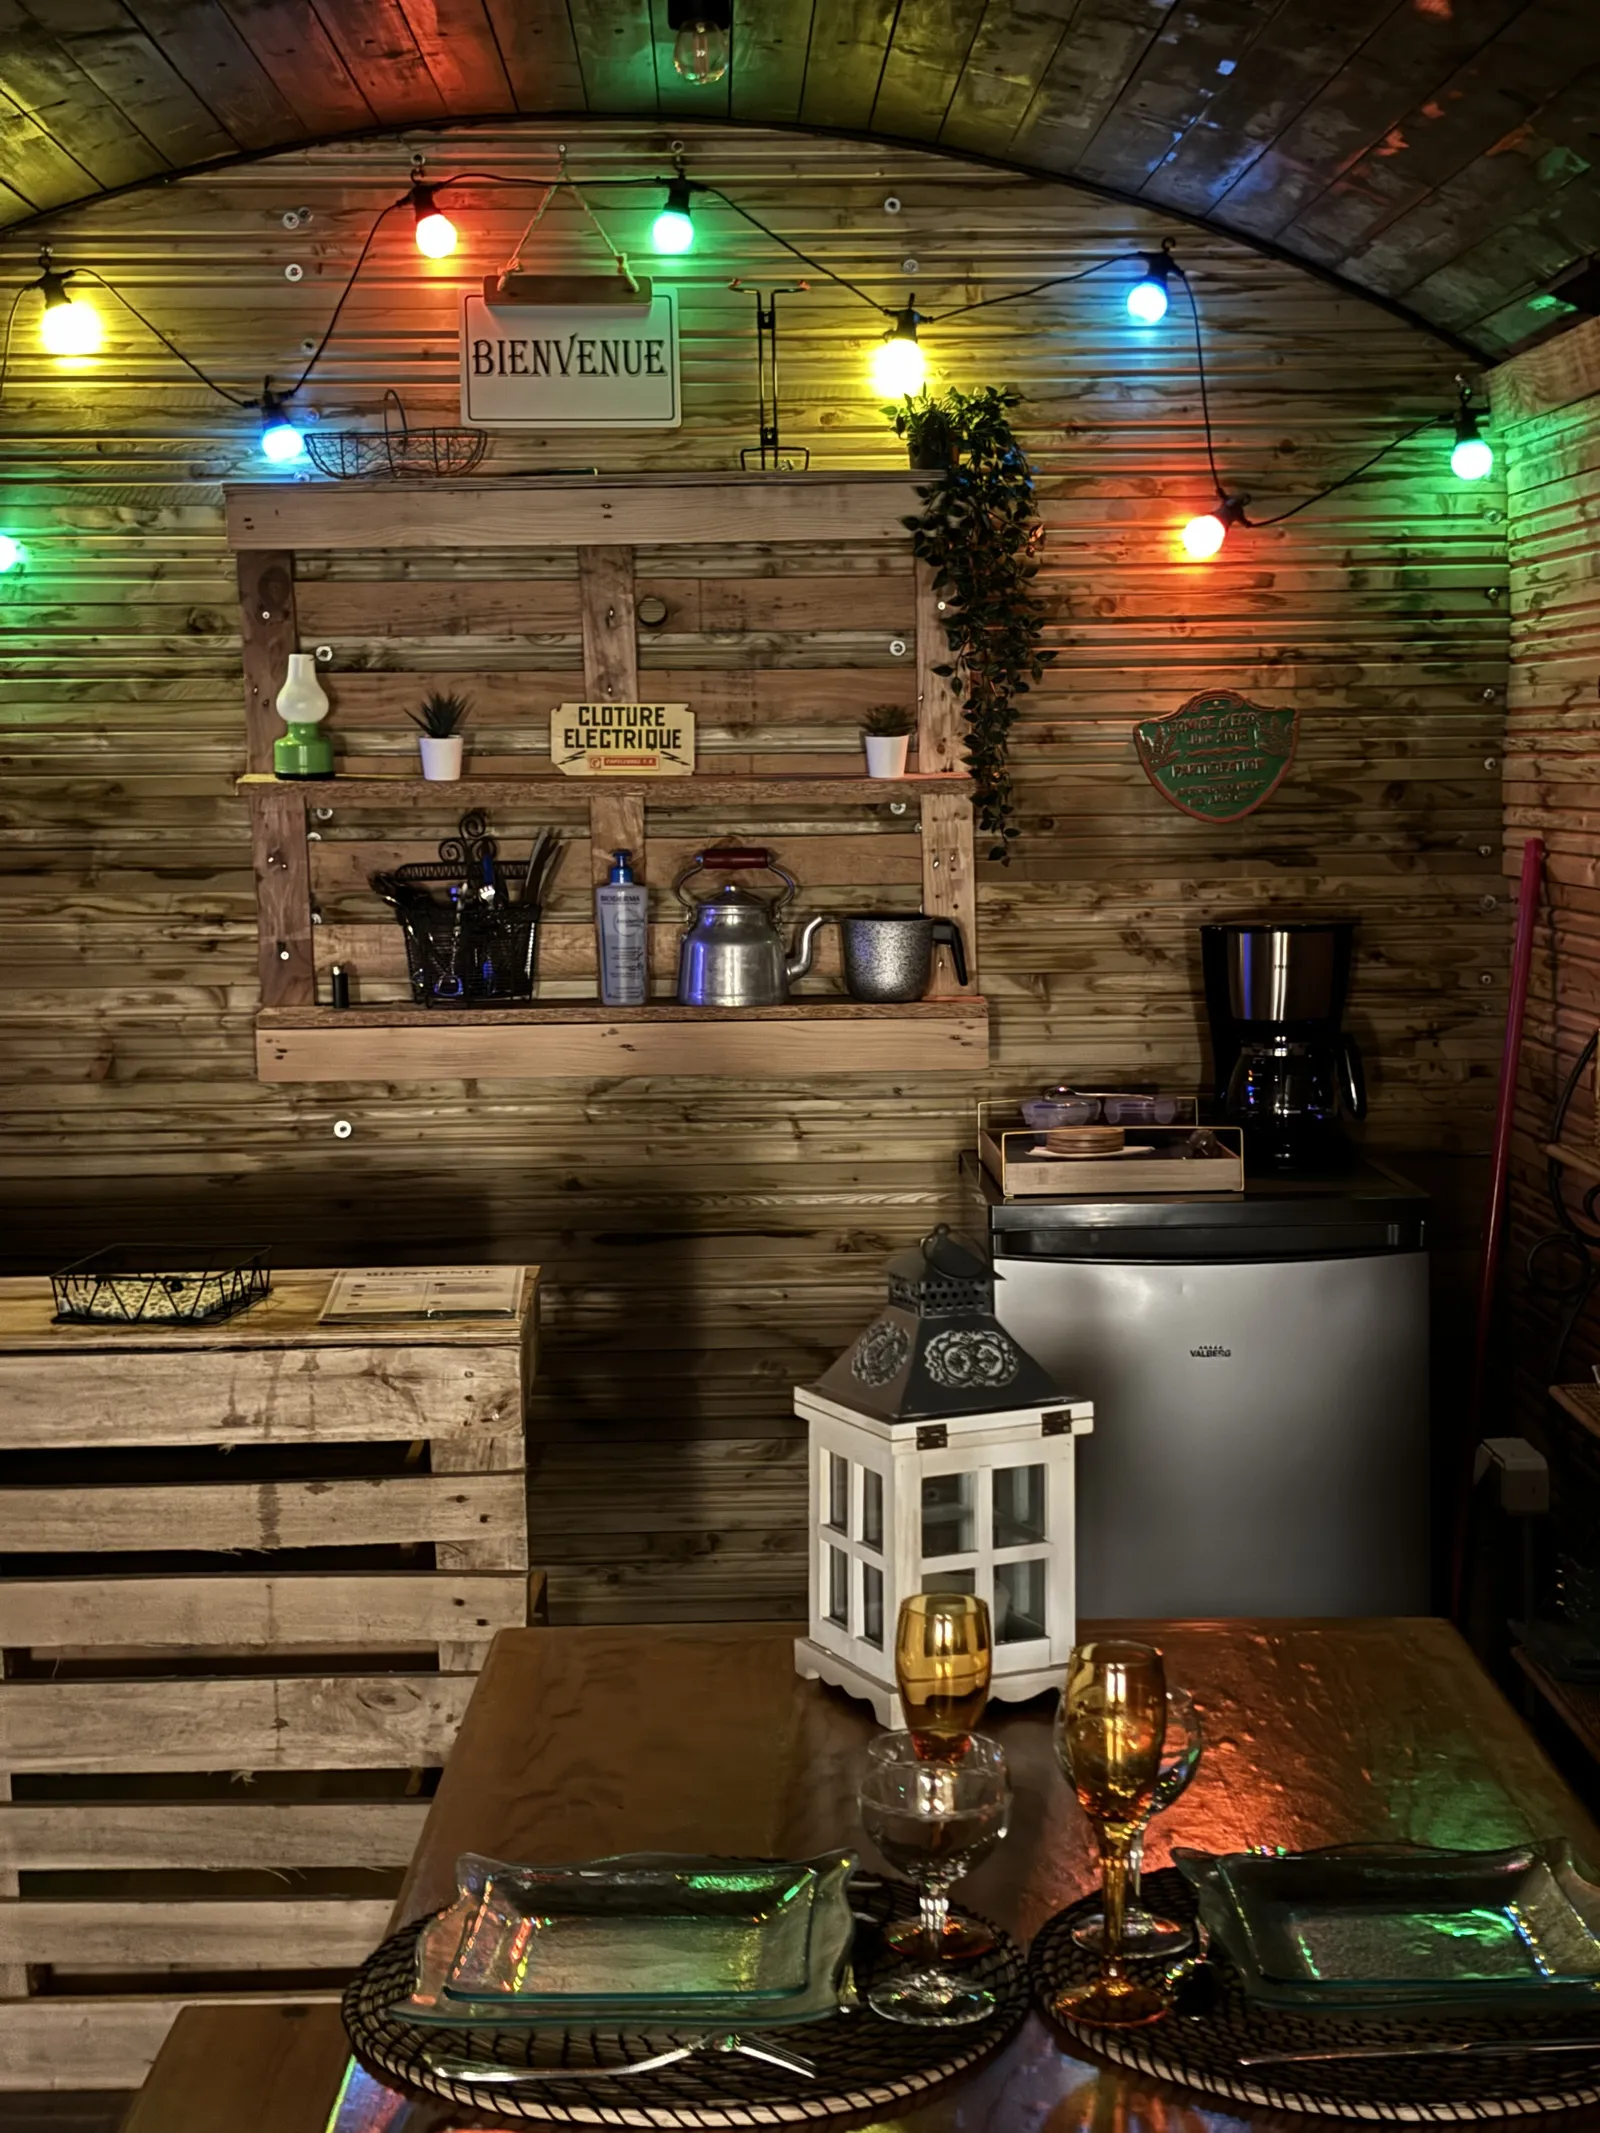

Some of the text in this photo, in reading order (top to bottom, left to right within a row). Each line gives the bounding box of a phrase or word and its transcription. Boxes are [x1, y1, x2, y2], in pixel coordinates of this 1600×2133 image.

[472, 333, 668, 377] BIENVENUE
[579, 706, 665, 727] CLOTURE
[564, 728, 682, 750] ELECTRIQUE
[1190, 1349, 1231, 1358] VALBERG
